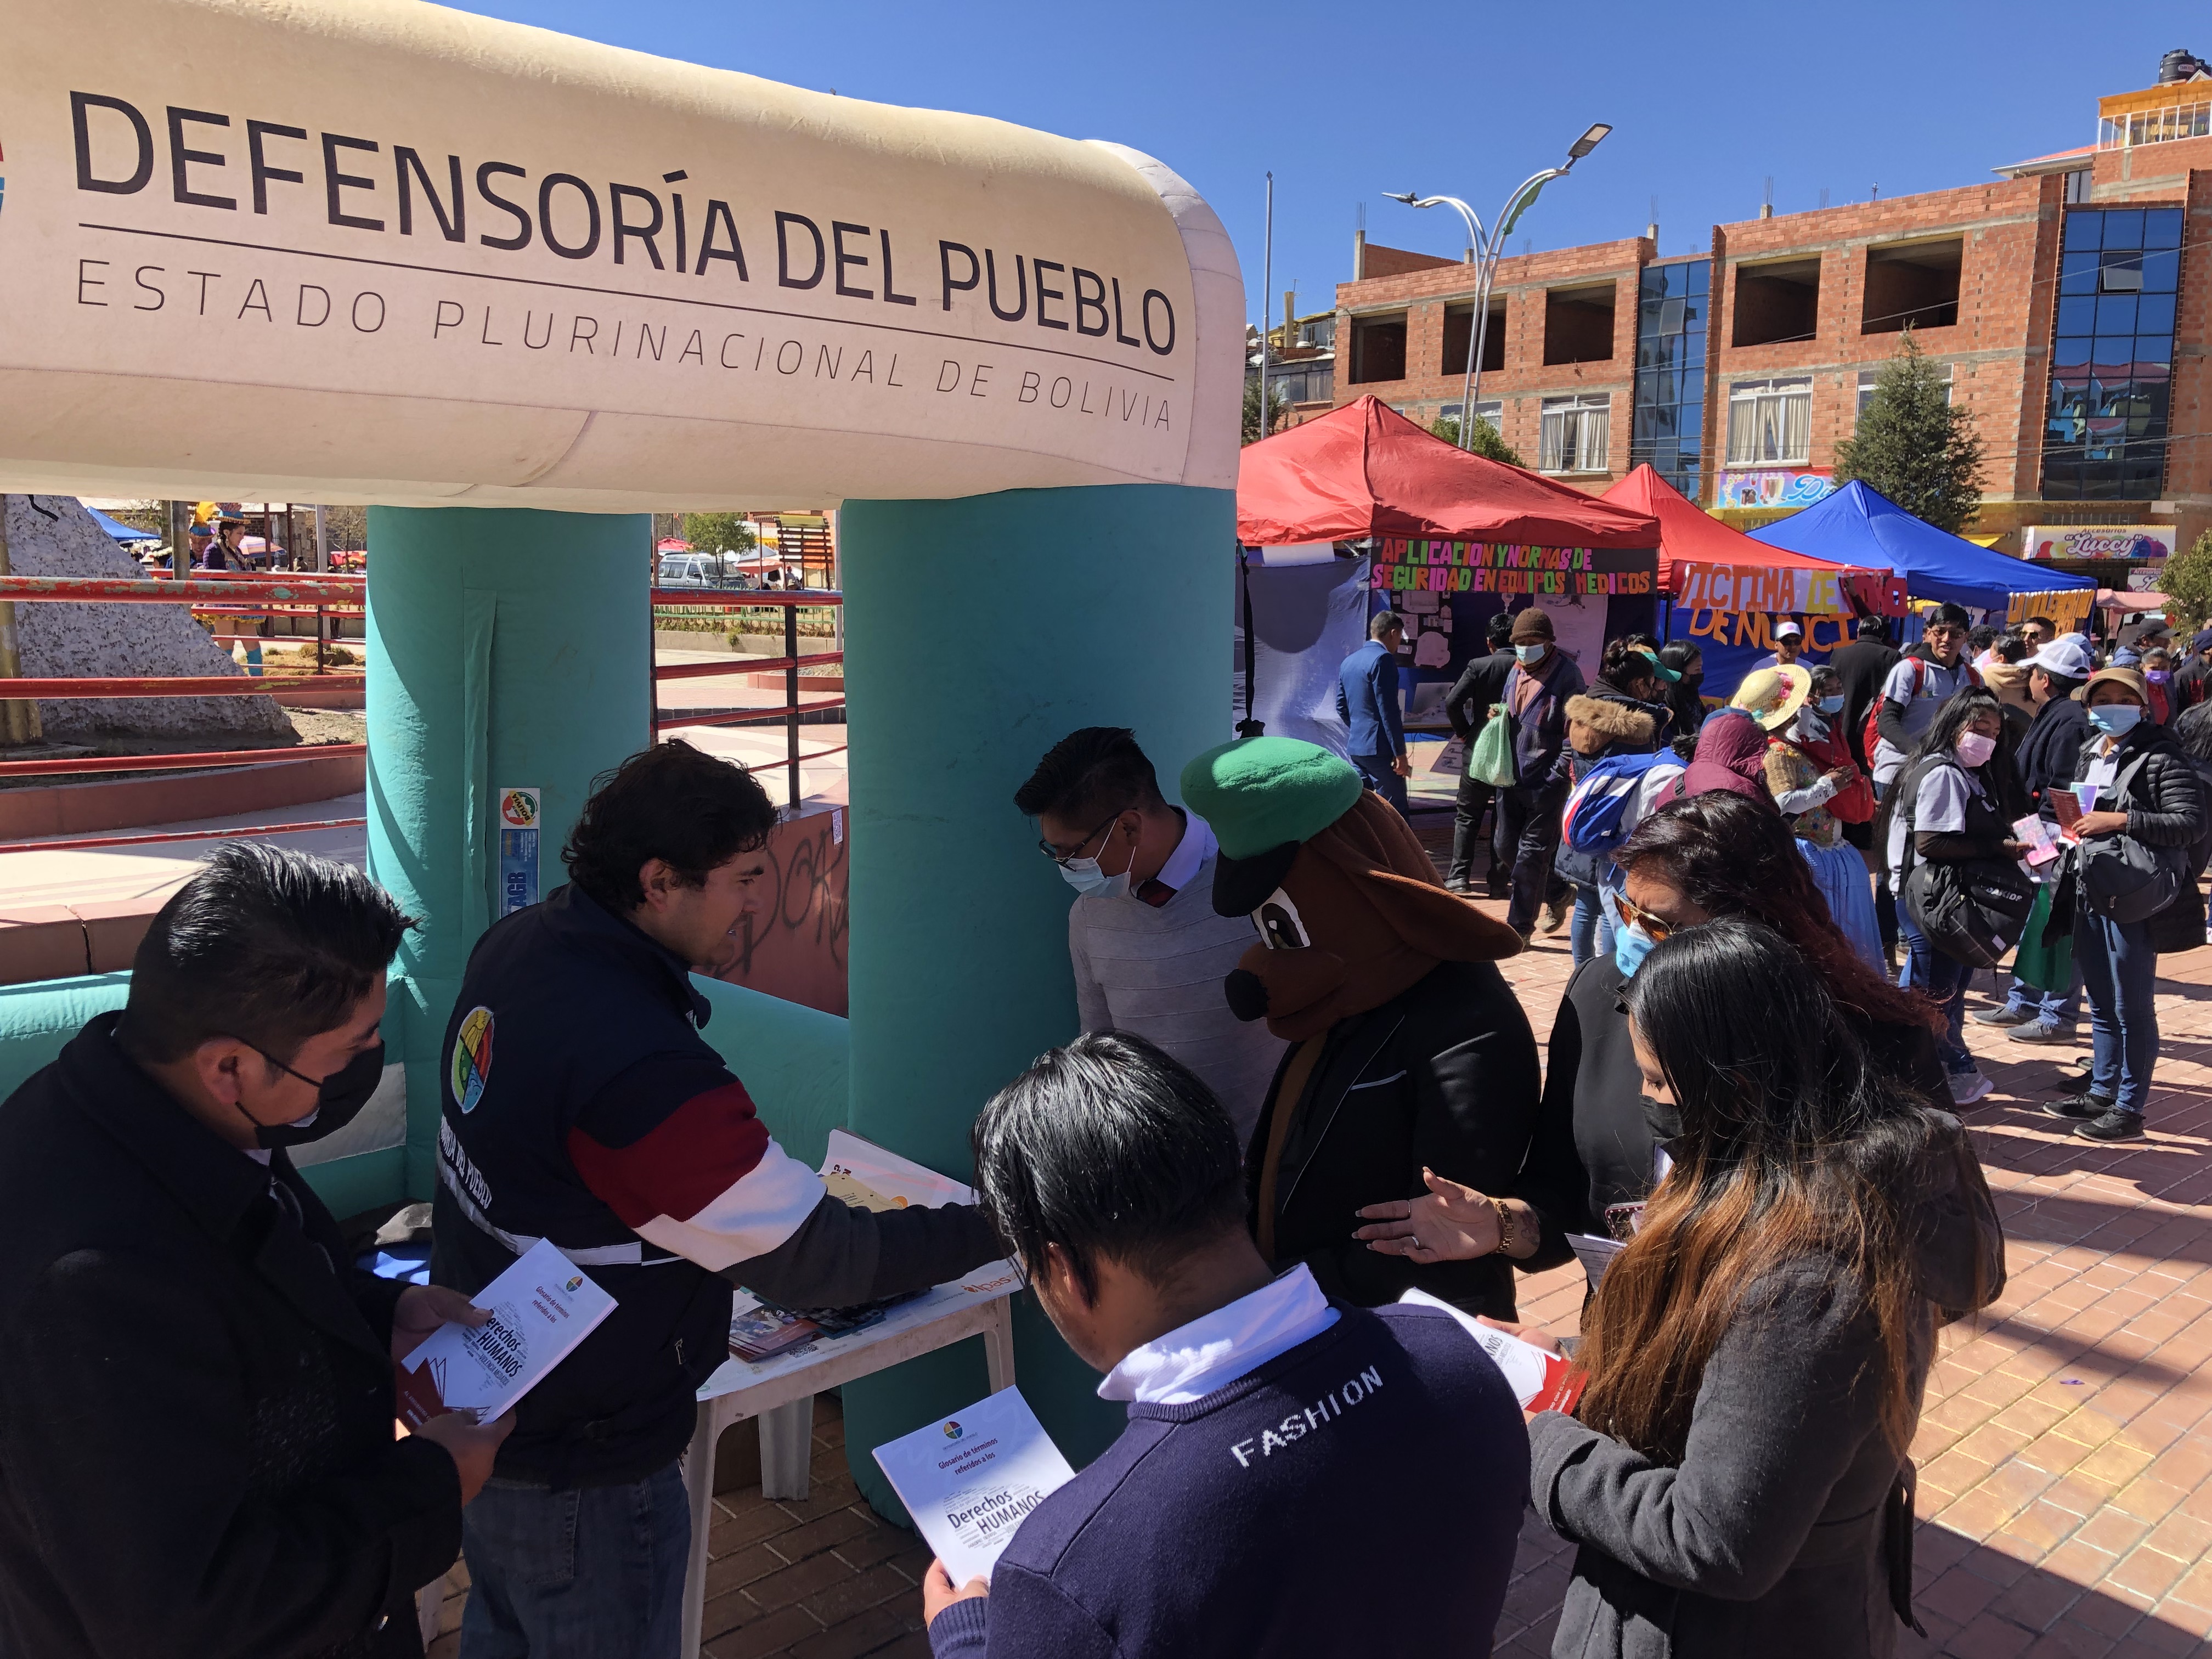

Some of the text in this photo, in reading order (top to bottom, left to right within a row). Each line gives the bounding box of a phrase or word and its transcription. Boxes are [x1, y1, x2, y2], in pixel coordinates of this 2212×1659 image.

[70, 91, 1176, 356] DEFENSORÍA DEL PUEBLO
[78, 259, 1171, 431] ESTADO PLURINACIONAL DE BOLIVIA
[1381, 538, 1495, 567] APLICACION
[1573, 548, 1592, 571] DE
[1372, 564, 1650, 595] SEGURIDAD EN EQUIPOS MEDICOS
[1805, 571, 1838, 613] DE
[512, 793, 529, 821] BOLIVIA
[532, 1300, 549, 1317] referidos
[535, 1286, 551, 1302] Glosario
[549, 1299, 556, 1307] de
[554, 1302, 570, 1319] términos
[486, 1308, 521, 1352] erechos
[476, 1331, 523, 1378] HUMANOS
[1231, 1365, 1383, 1469] FASHION
[938, 1438, 998, 1469] Glosario de términos
[955, 1458, 981, 1475] referidos
[987, 1452, 996, 1460] los
[947, 1491, 1013, 1529] Derechos
[977, 1491, 1045, 1535] HUMANOS
